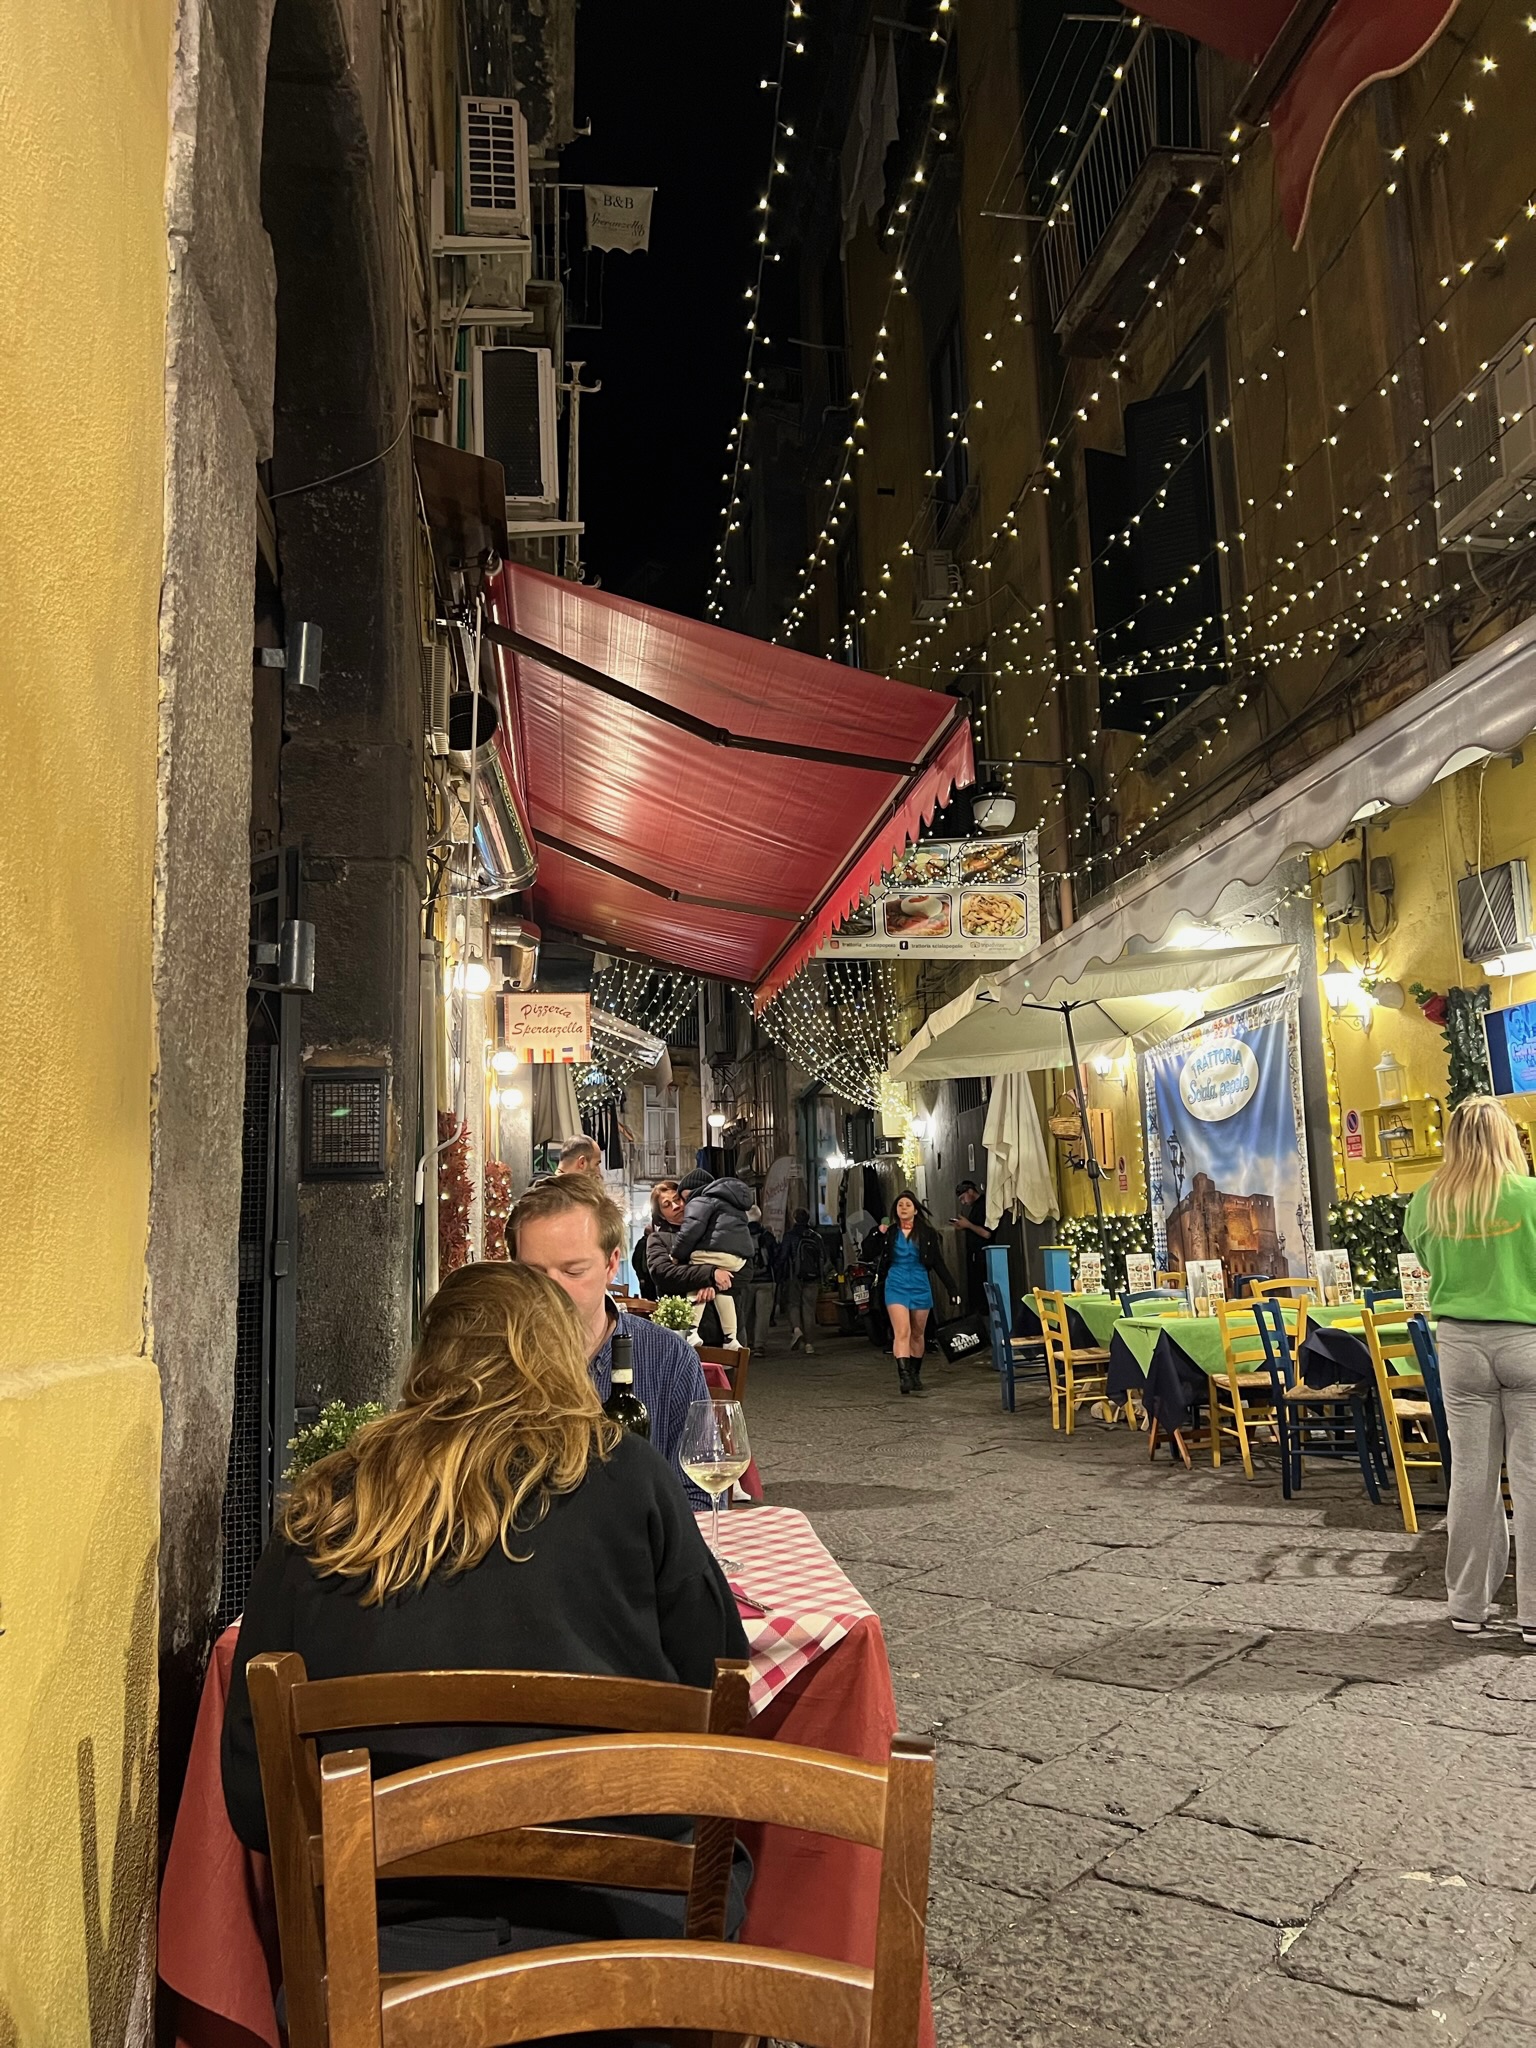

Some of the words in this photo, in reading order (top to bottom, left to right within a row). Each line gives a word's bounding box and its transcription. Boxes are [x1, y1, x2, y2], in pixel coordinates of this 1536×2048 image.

[603, 194, 634, 209] B&B
[591, 212, 645, 231] Speranzella
[520, 1004, 572, 1020] Pizzeria
[511, 1022, 584, 1037] Speranzella
[1191, 1048, 1244, 1079] TRATTORIA
[1219, 1067, 1250, 1107] popolo
